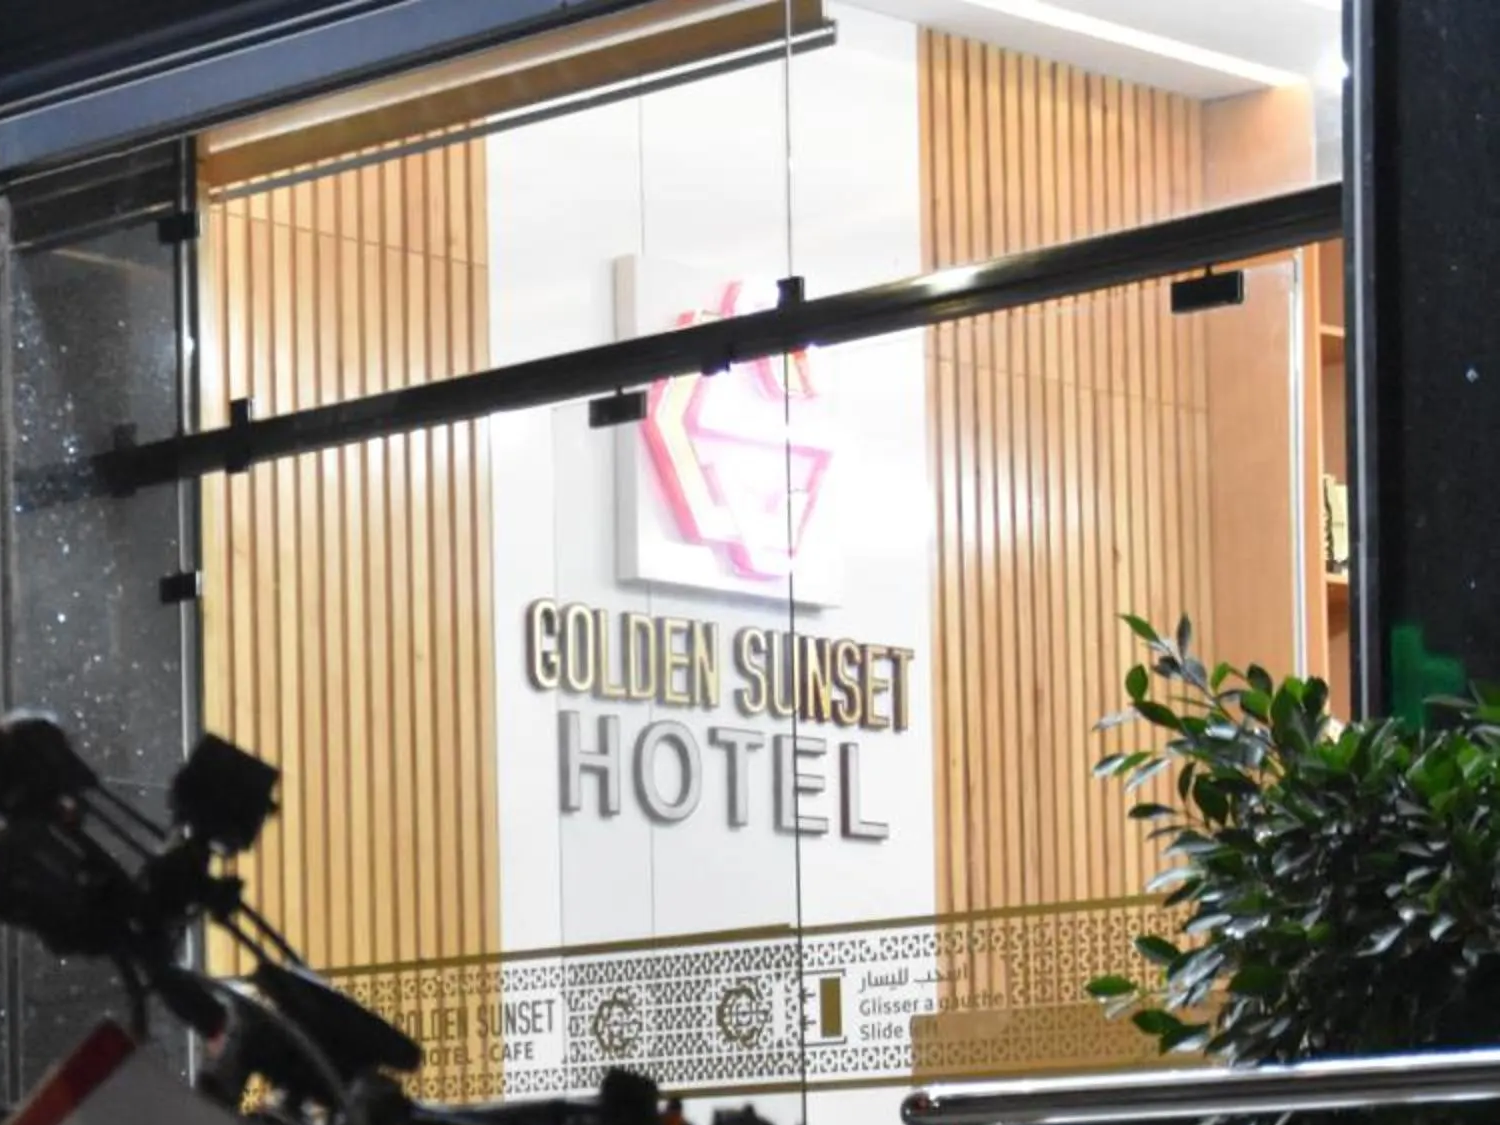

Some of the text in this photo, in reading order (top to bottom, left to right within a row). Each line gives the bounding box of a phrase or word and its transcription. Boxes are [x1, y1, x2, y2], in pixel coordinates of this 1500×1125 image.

[526, 598, 914, 732] GOLDEN SUNSET
[558, 710, 889, 841] HOTEL
[477, 1000, 556, 1039] SUNSET
[859, 995, 918, 1017] Glisser
[859, 1021, 904, 1041] Slide
[489, 1041, 534, 1062] CAFE
